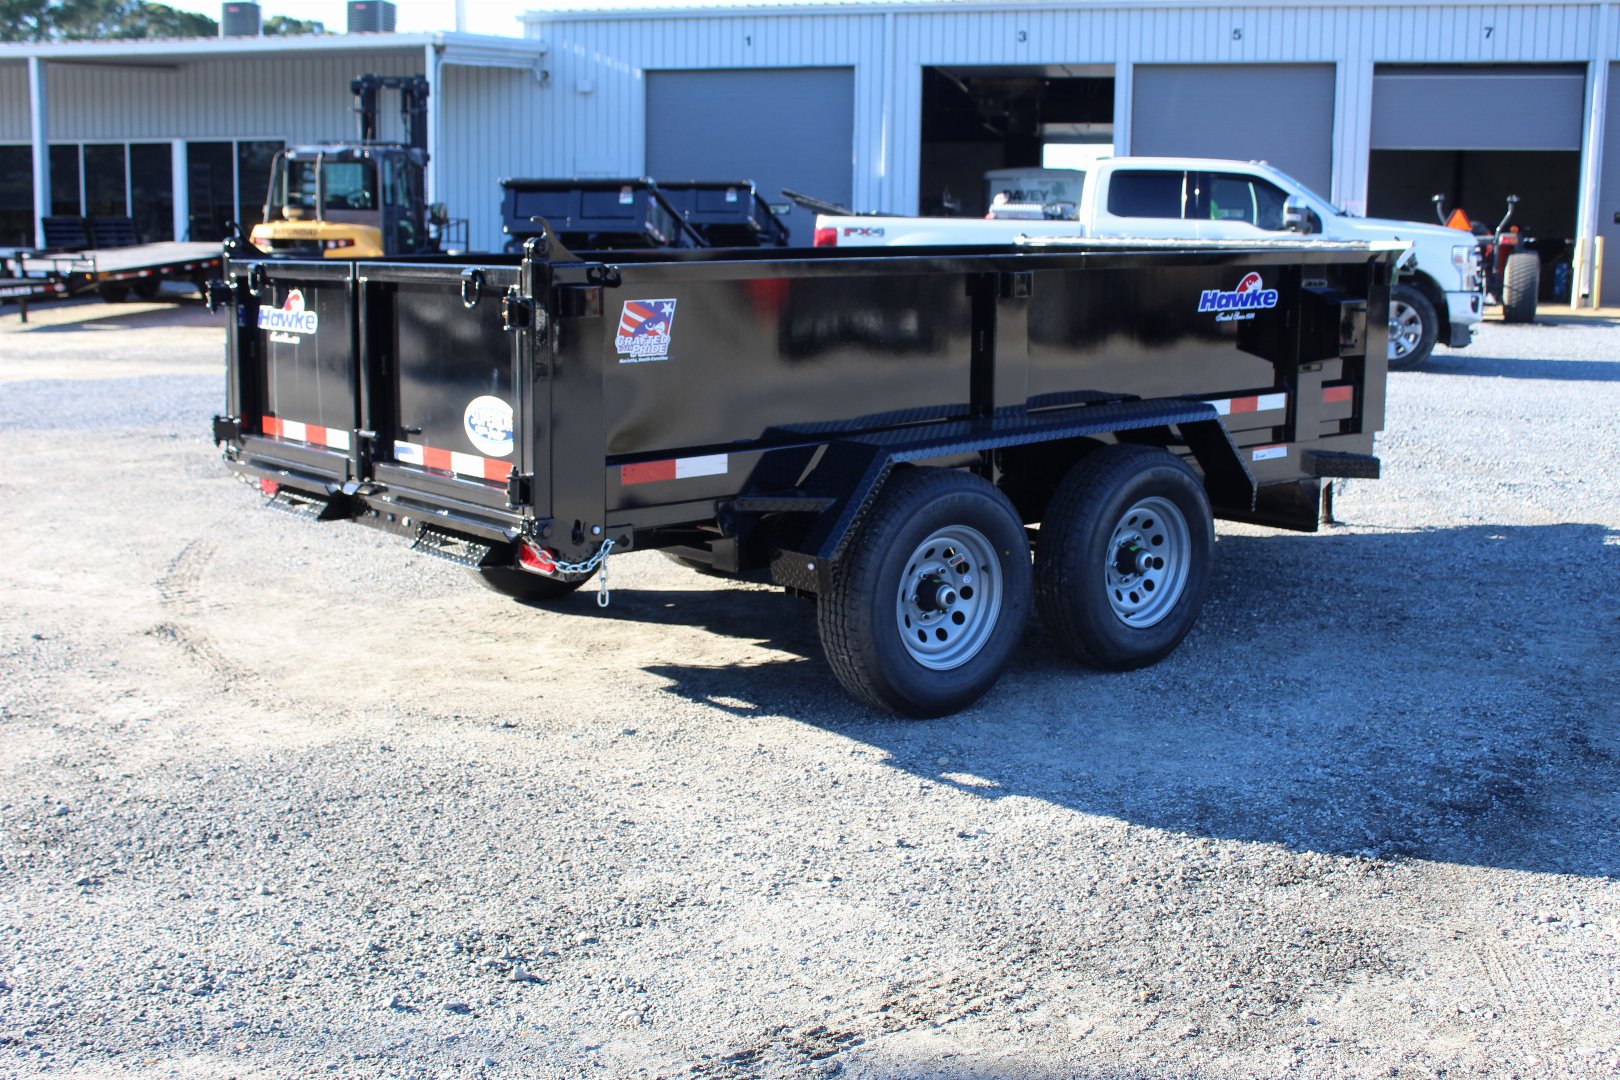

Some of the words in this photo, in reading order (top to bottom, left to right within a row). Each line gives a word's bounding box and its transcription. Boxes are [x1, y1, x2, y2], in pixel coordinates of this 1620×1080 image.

[1018, 30, 1027, 42] 3
[1232, 28, 1242, 40] 5
[1484, 27, 1493, 38] 7
[1003, 189, 1048, 201] DAVEY
[844, 227, 884, 237] FX4
[1199, 289, 1277, 310] Hawke
[258, 308, 316, 330] Hawke
[616, 334, 670, 346] CRAFTED
[631, 344, 667, 356] PRIDE
